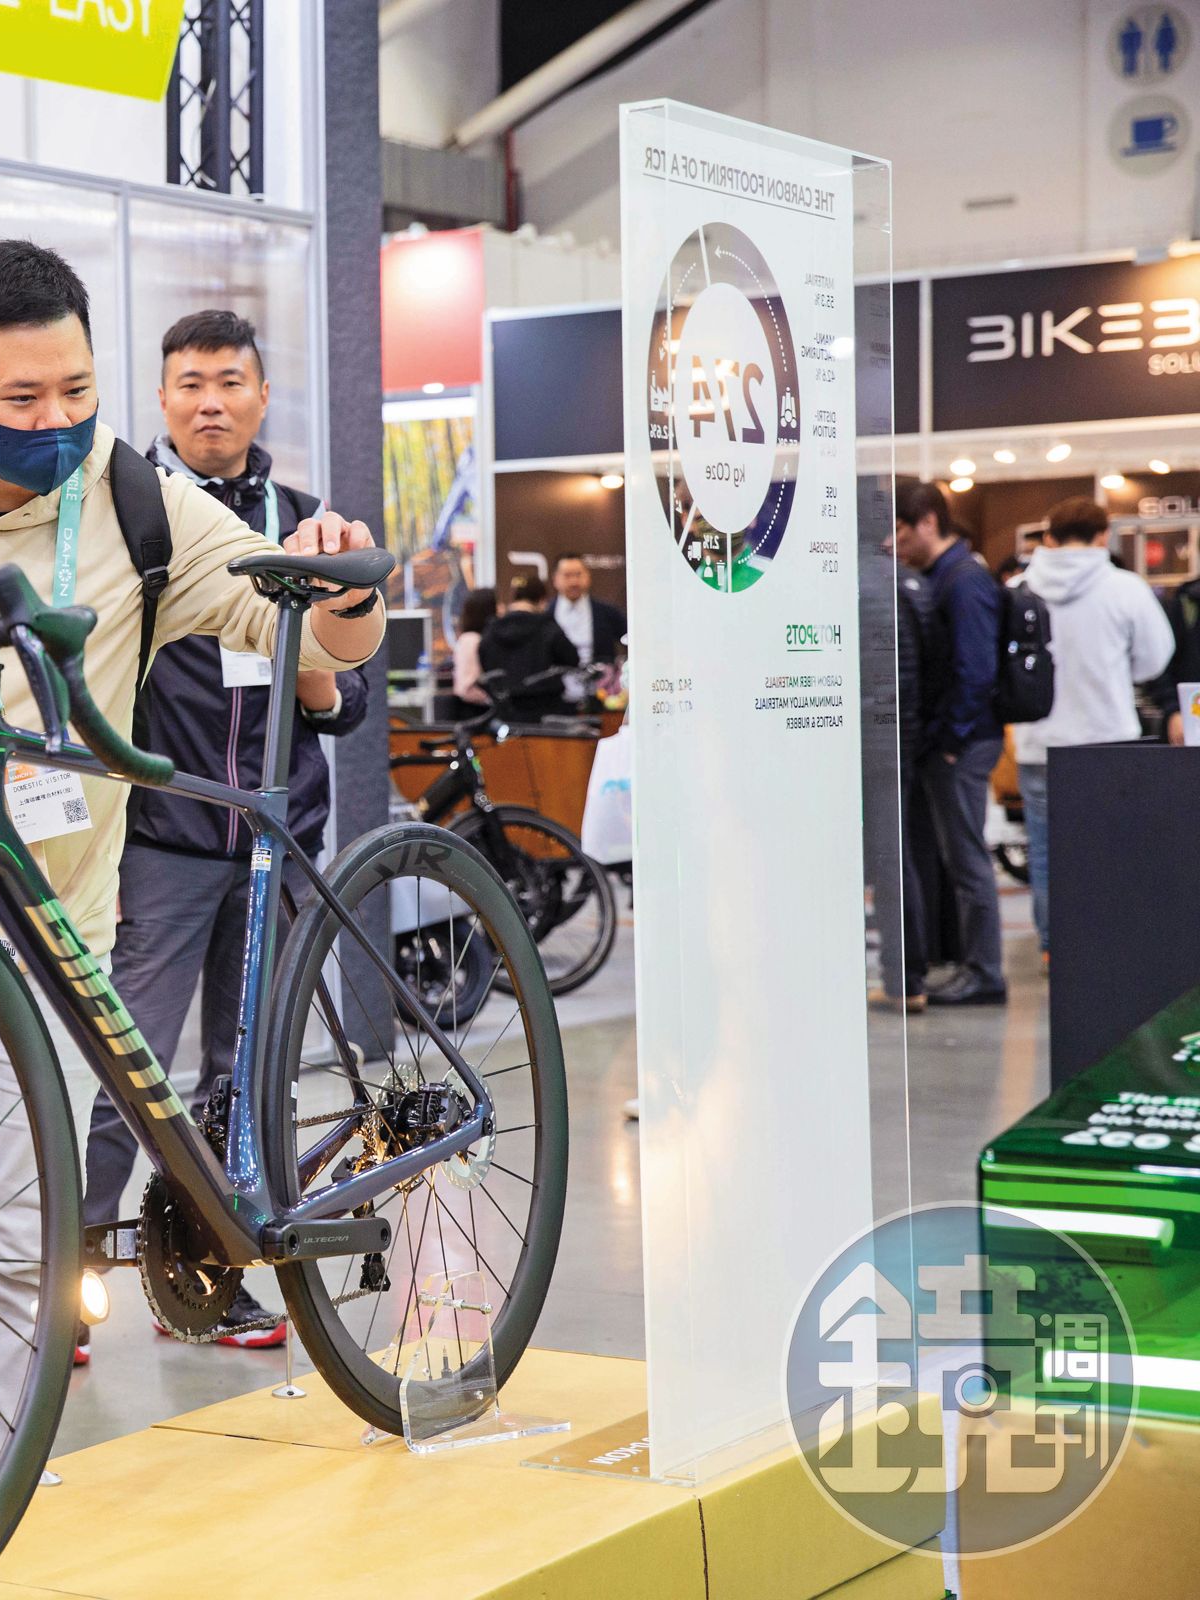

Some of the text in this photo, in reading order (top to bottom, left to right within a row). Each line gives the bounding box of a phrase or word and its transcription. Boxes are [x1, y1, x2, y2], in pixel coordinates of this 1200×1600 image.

[12, 772, 72, 793] DOMESTIC VISITOR
[303, 1235, 350, 1244] ULTEGRA
